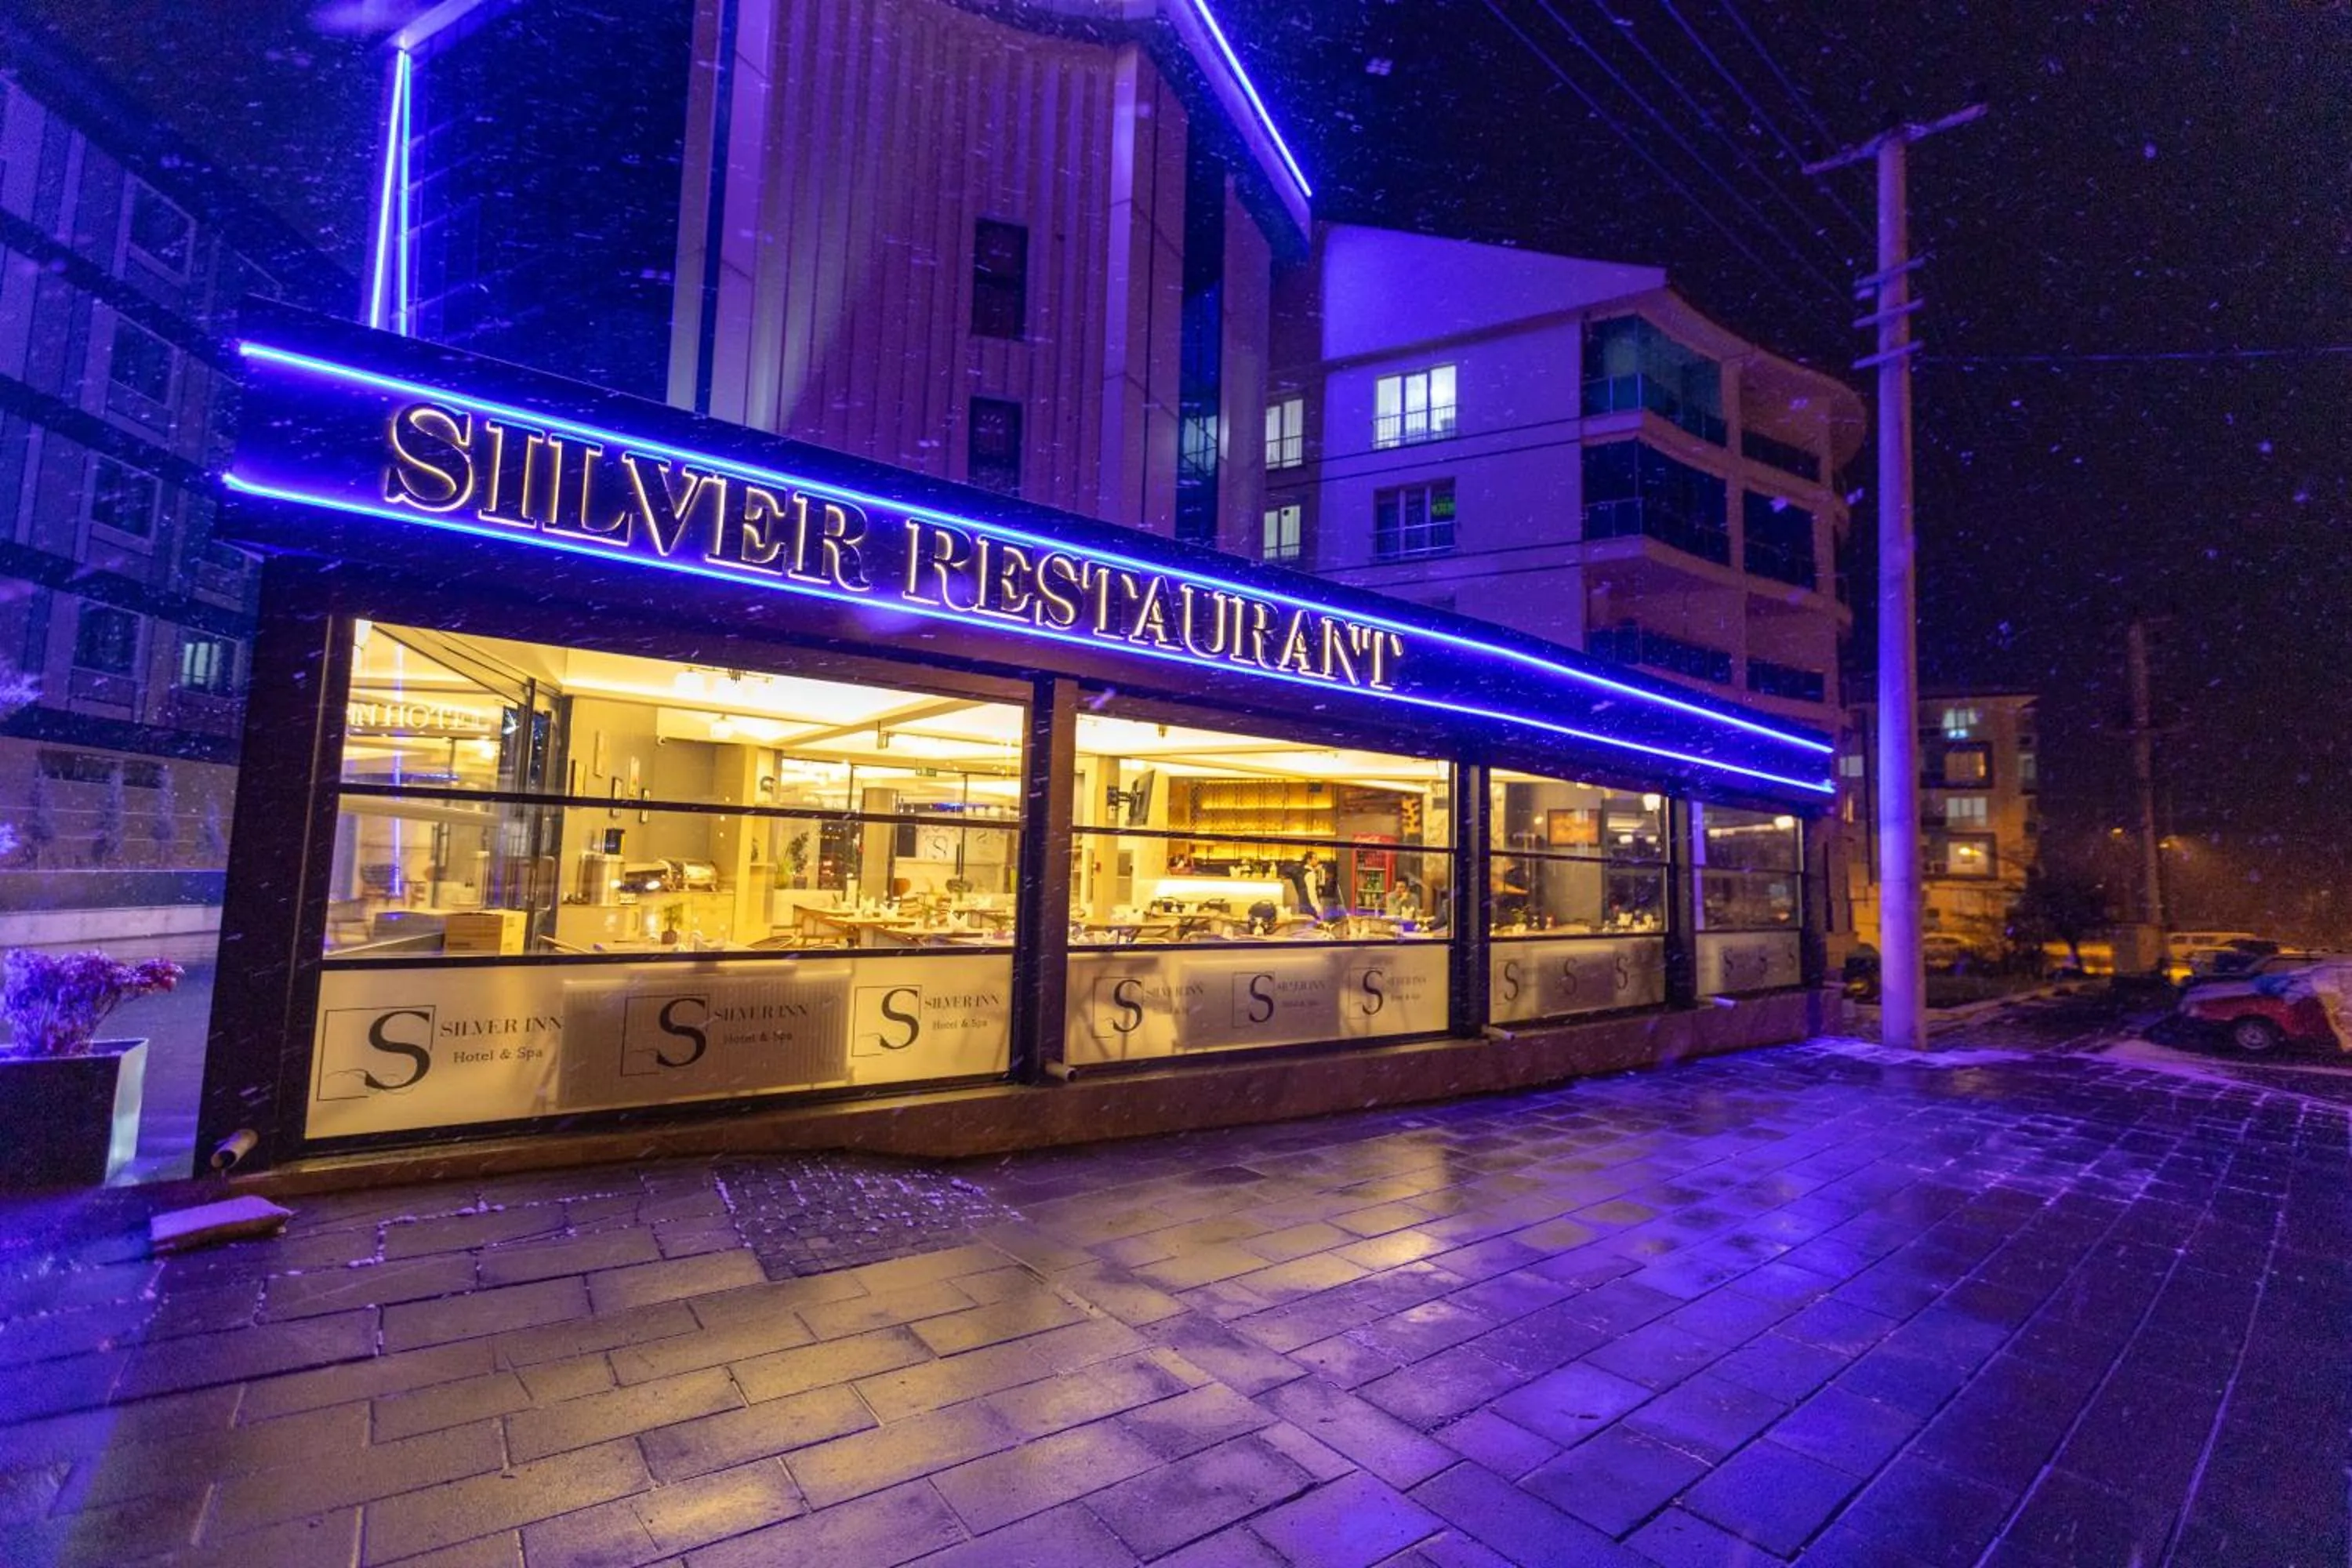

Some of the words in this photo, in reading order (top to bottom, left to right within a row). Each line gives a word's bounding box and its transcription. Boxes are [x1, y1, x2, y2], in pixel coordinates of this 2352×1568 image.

[383, 403, 870, 593] SILVER
[902, 517, 1404, 690] RESTAURANT
[1113, 979, 1142, 1032] S
[1249, 974, 1273, 1022] S
[1363, 970, 1383, 1014] S
[1504, 961, 1519, 1001] S
[440, 1018, 517, 1037] SILVER
[525, 1015, 564, 1033] INN
[656, 997, 706, 1067] S
[880, 988, 920, 1049] S
[365, 1011, 431, 1089] S
[453, 1050, 494, 1064] Hotel
[499, 1048, 511, 1060] &
[517, 1046, 543, 1061] Spa
